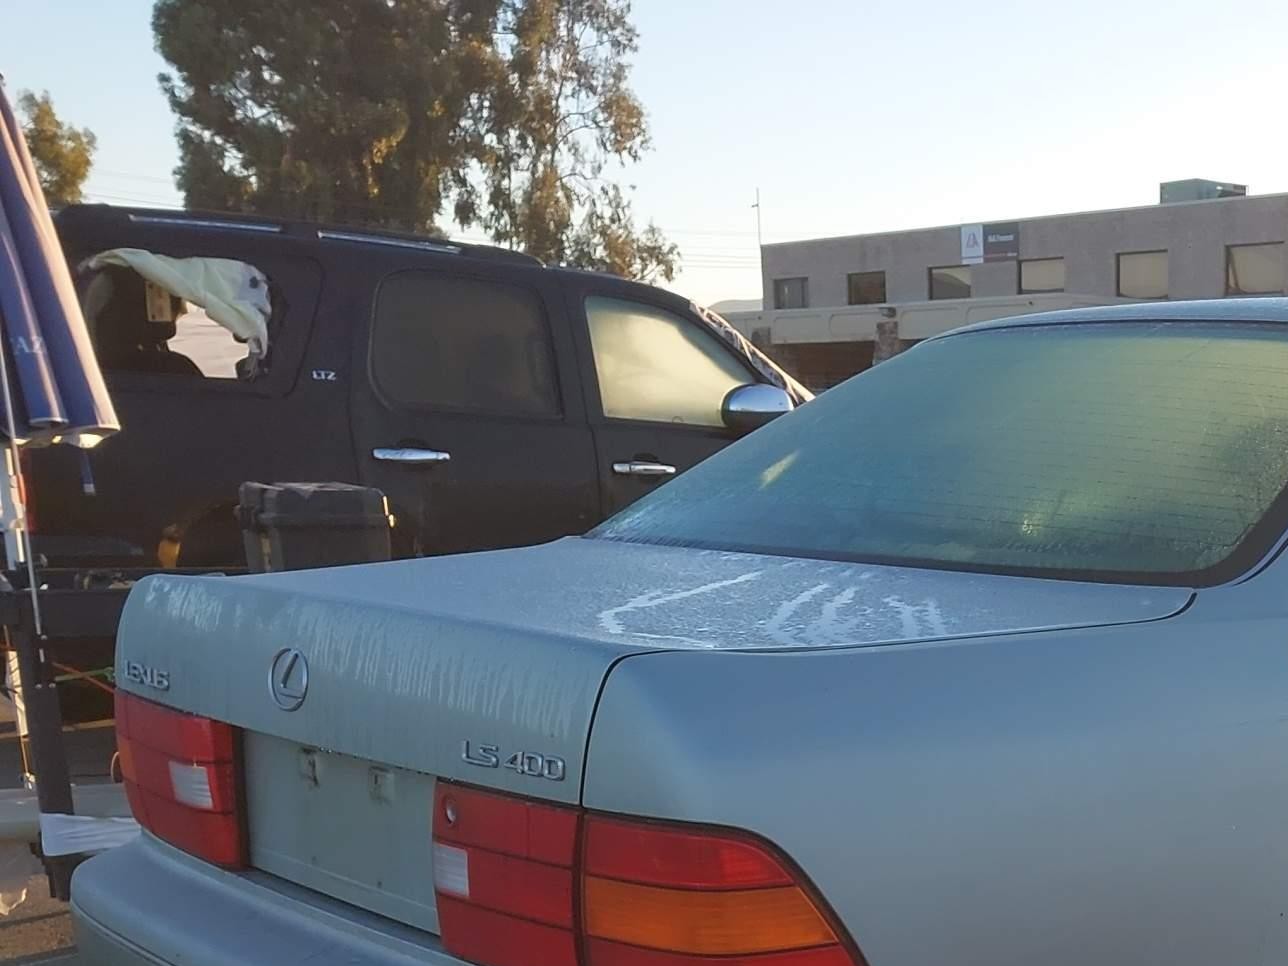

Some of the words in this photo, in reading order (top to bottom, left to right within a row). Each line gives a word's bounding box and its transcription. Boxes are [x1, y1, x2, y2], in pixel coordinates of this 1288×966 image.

[312, 369, 337, 380] LTZ
[461, 739, 499, 769] LS
[503, 751, 566, 782] 400
